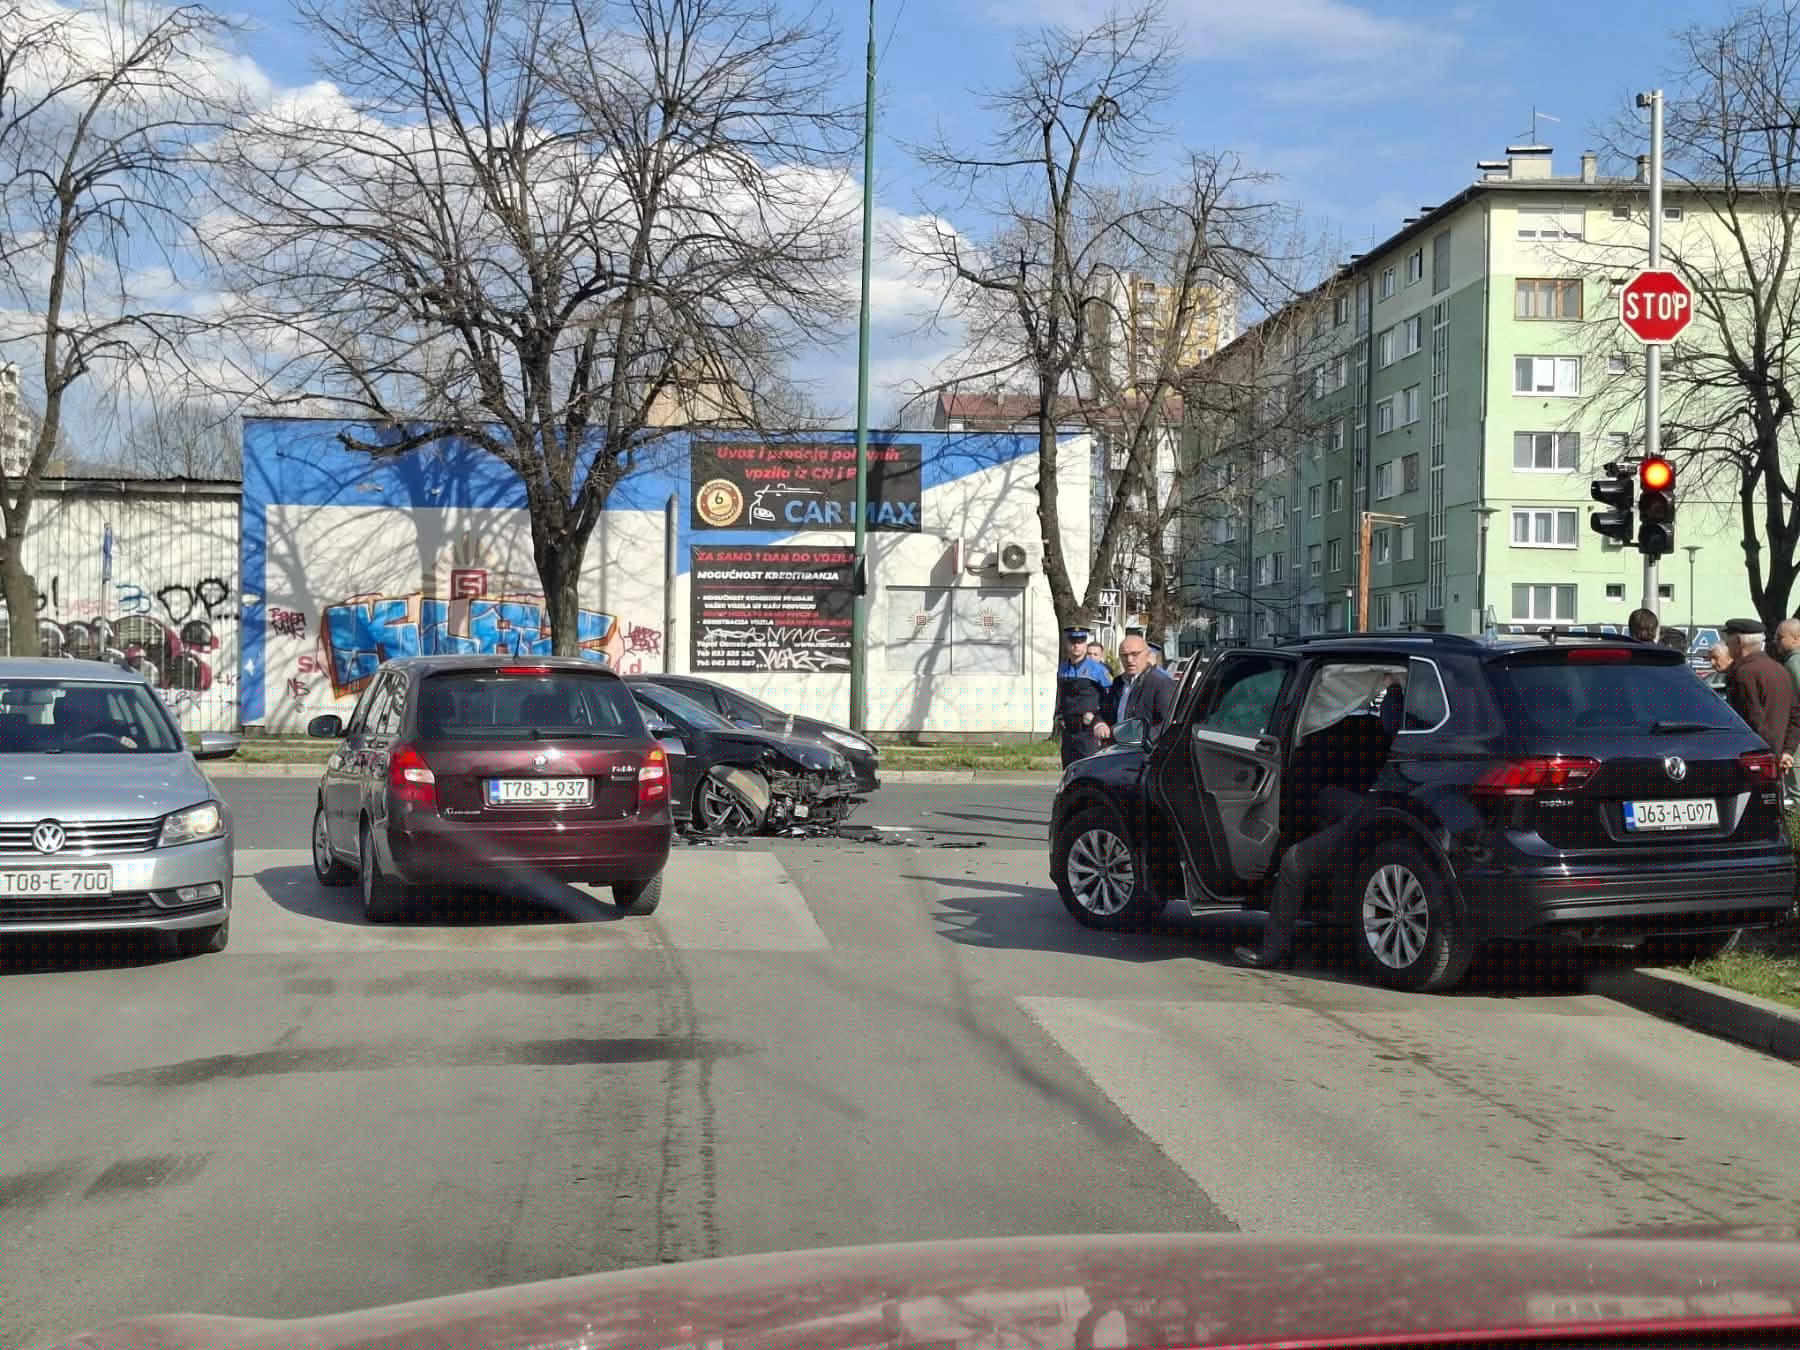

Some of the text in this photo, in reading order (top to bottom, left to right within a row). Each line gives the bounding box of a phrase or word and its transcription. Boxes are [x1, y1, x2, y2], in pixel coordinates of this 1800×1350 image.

[1626, 292, 1688, 320] STOP
[812, 467, 834, 480] CH
[715, 492, 724, 505] 6
[785, 501, 917, 524] CAR MAX
[697, 552, 714, 562] ZA
[717, 552, 752, 562] SAMO
[762, 552, 790, 562] DAN
[792, 552, 811, 562] DO
[697, 569, 839, 581] MOGUĆNOST KREDITIRANJA
[503, 781, 585, 797] T78-J-937
[1637, 803, 1714, 825] J63-A-097
[3, 872, 109, 892] T08-E-700
